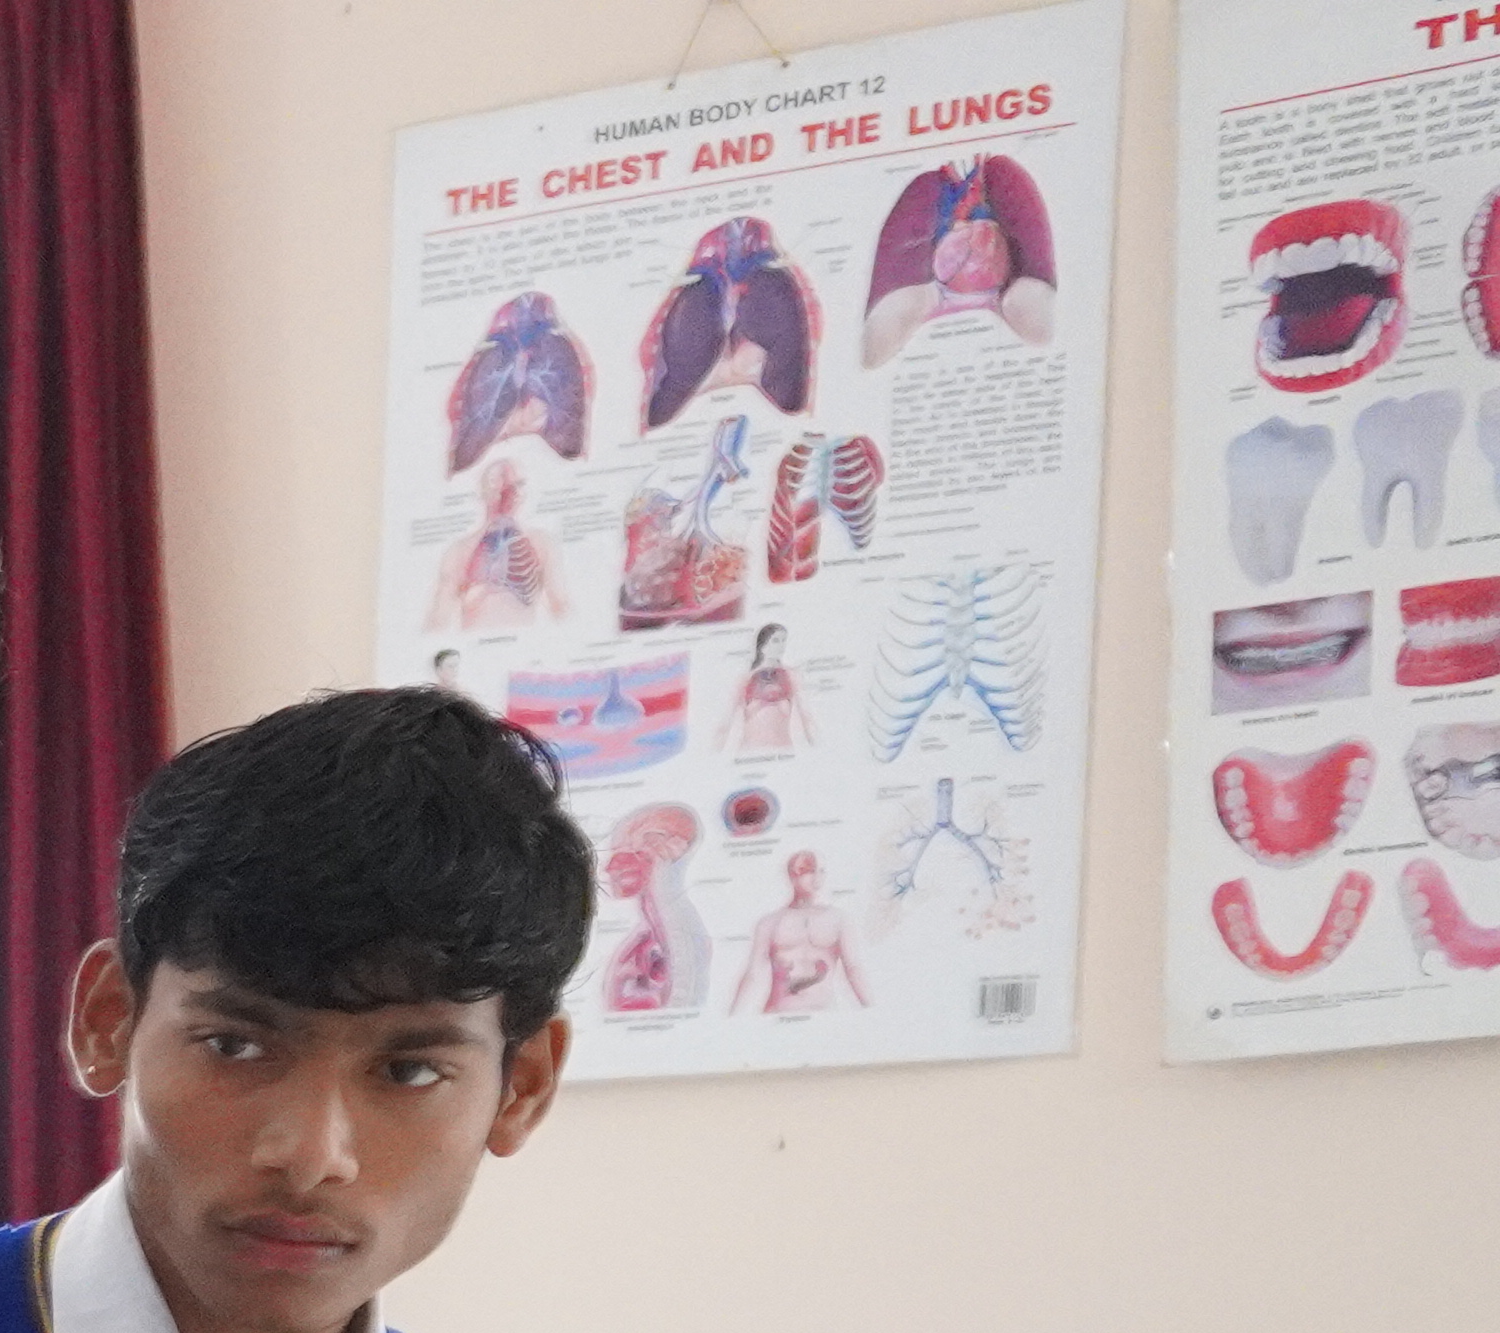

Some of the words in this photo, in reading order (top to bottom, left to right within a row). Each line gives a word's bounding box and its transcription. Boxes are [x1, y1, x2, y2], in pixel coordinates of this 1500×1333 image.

[446, 177, 520, 216] THE
[542, 150, 668, 199] CHEST
[691, 131, 775, 173] AND
[800, 113, 881, 152] THE
[908, 84, 1053, 136] LUNGS
[594, 112, 680, 143] HUMAN
[689, 98, 758, 126] BODY
[764, 82, 851, 113] CHART
[859, 75, 886, 96] 12
